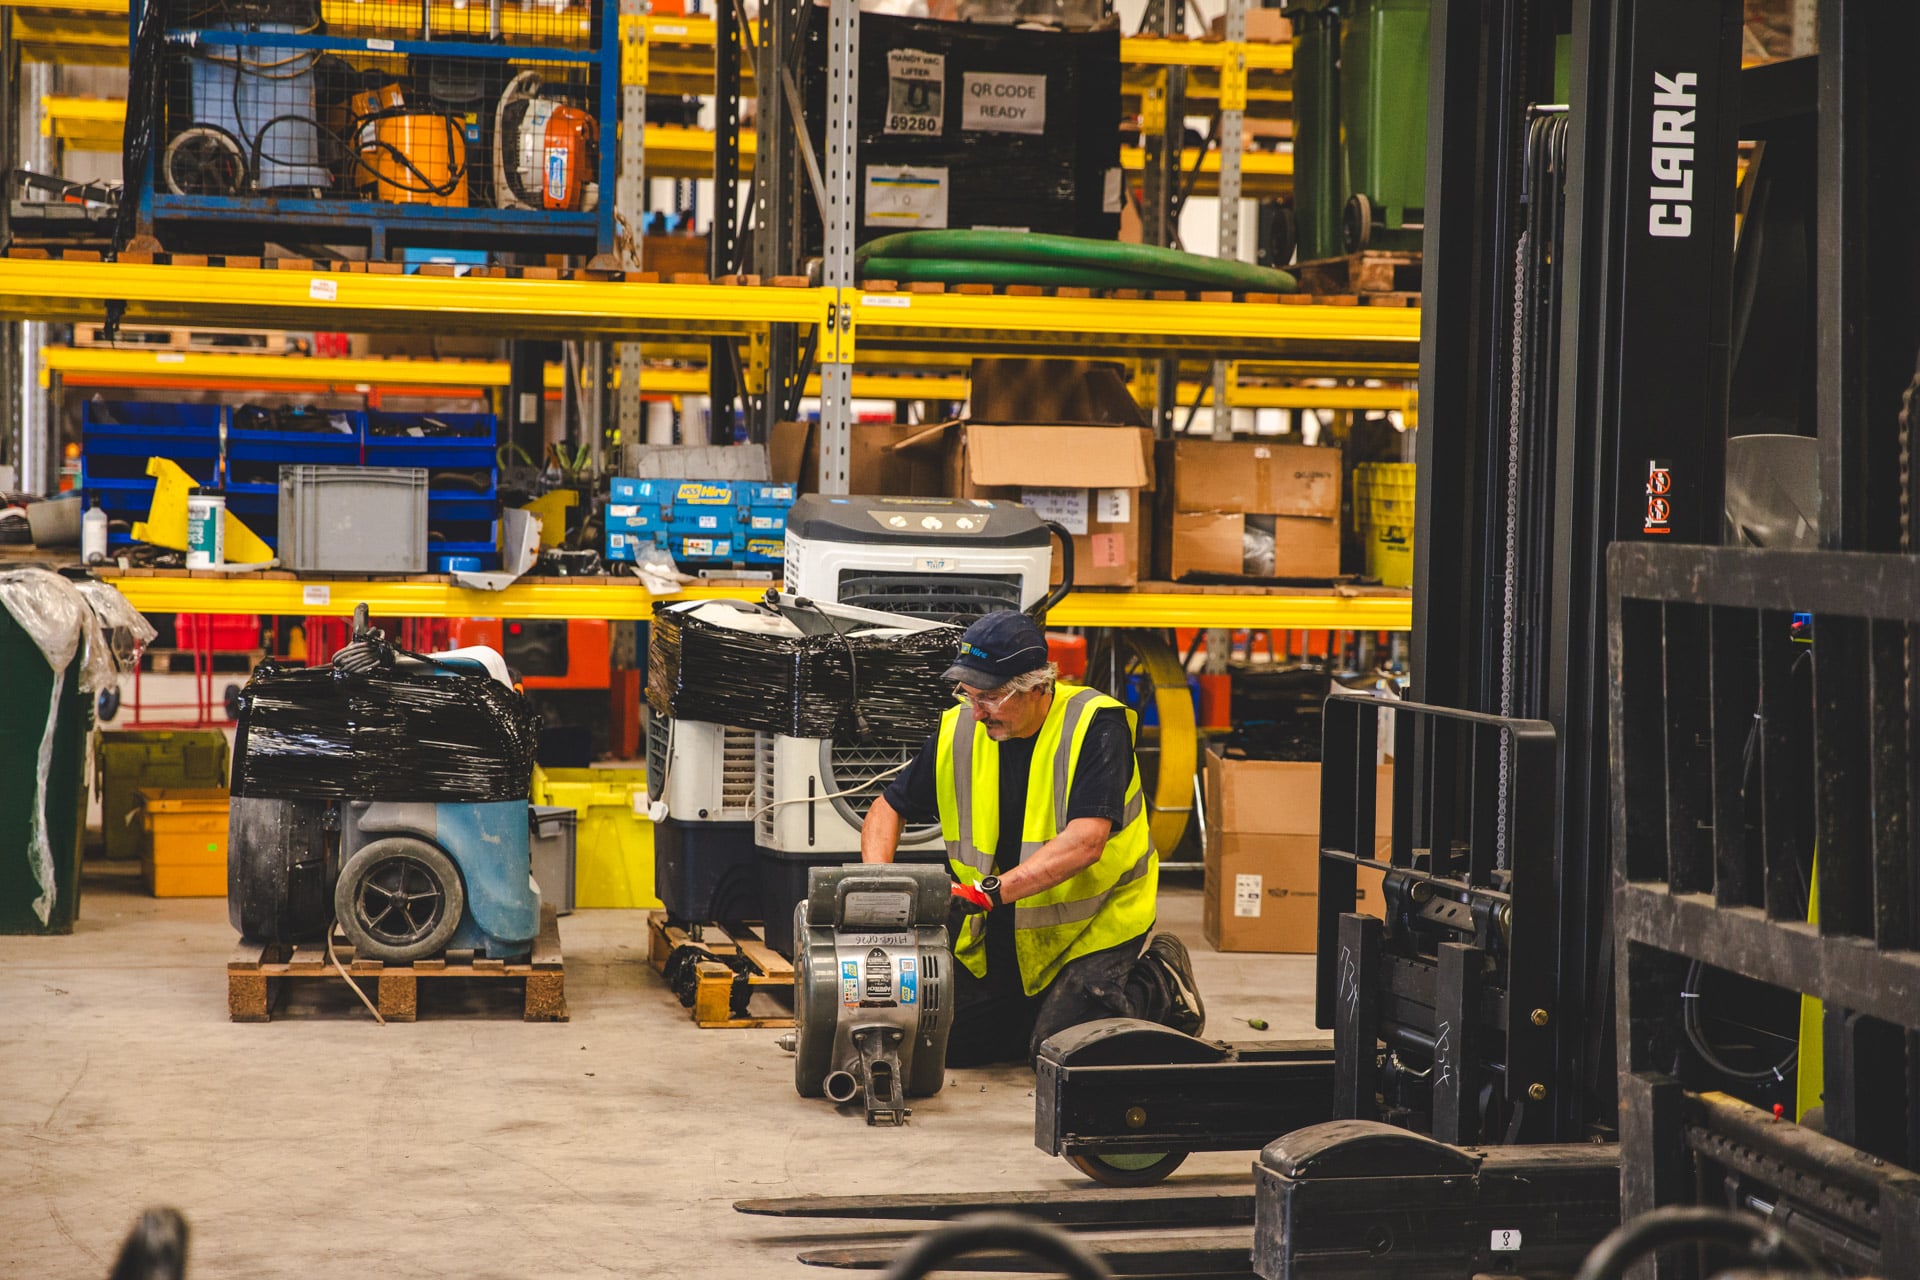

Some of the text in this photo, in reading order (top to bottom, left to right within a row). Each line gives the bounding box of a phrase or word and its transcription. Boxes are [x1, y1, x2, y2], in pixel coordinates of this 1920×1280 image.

[923, 57, 940, 66] VAC
[901, 68, 930, 77] LIFTER
[971, 82, 1036, 98] QR CODE
[980, 105, 1026, 119] READY
[891, 115, 936, 132] 69280
[1649, 71, 1697, 237] CLARK
[701, 485, 728, 499] Hire
